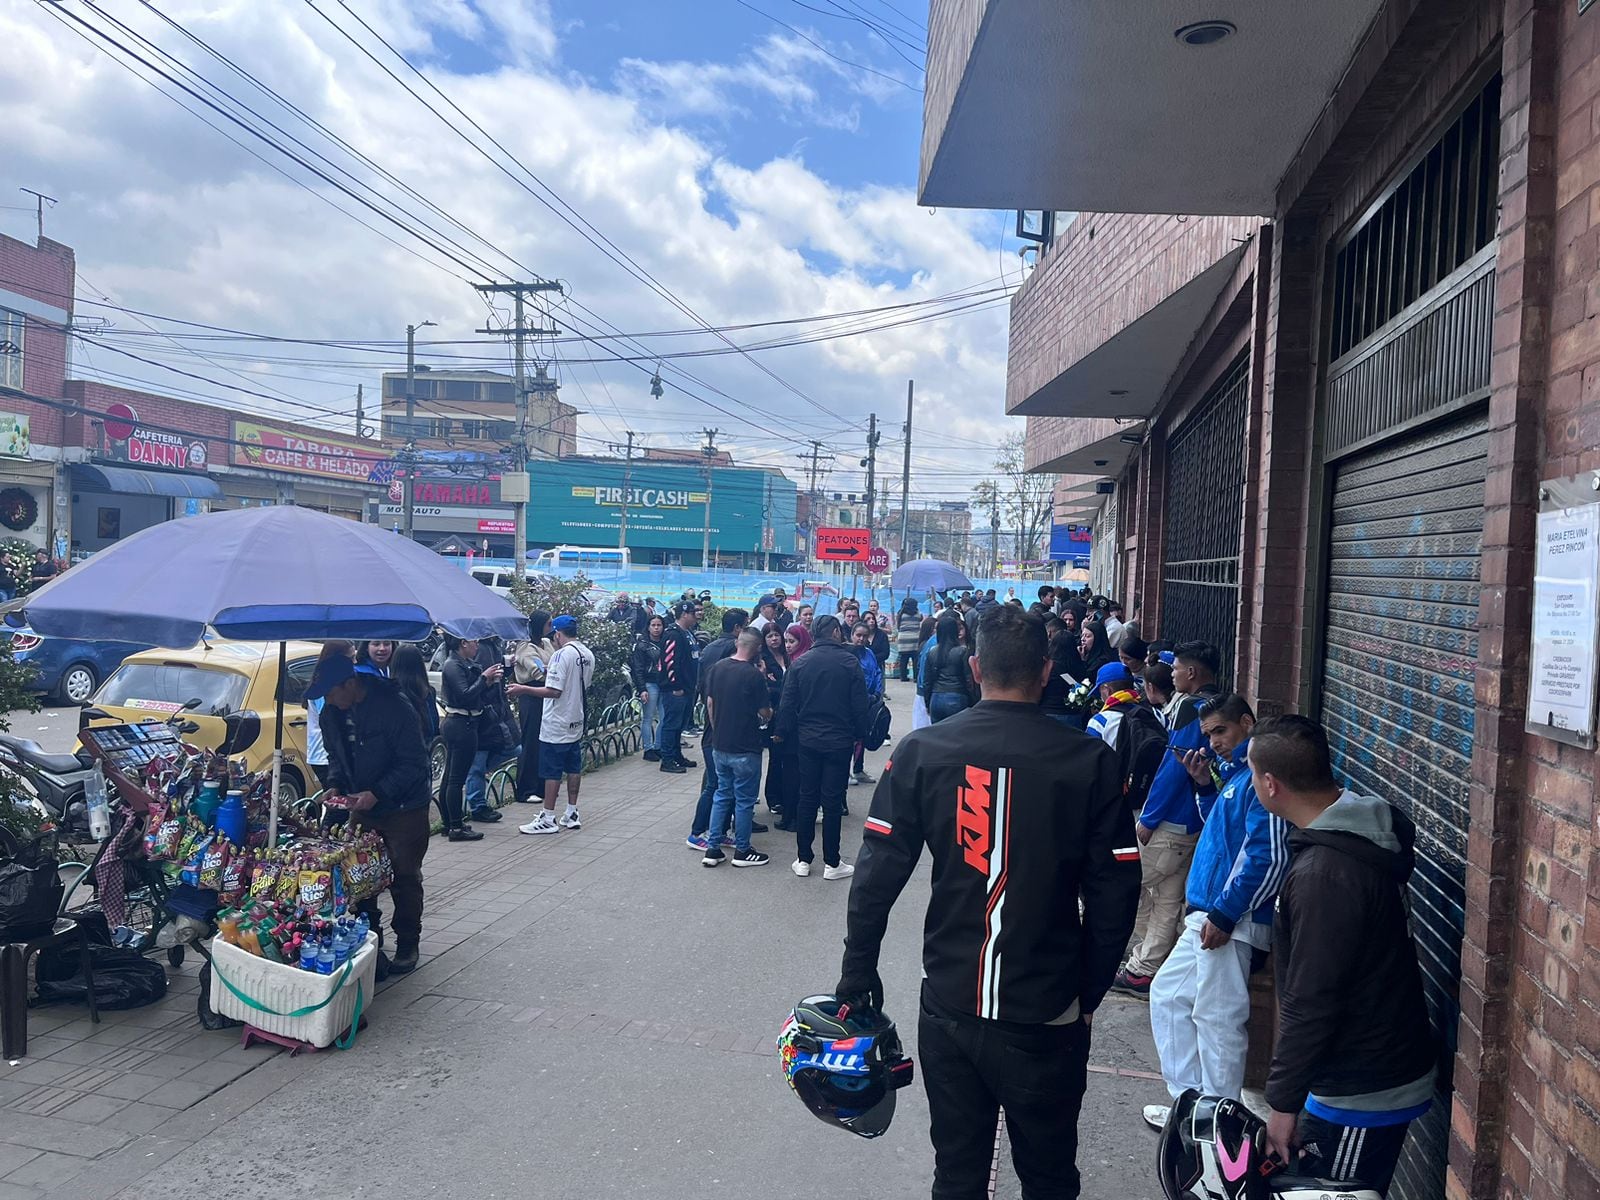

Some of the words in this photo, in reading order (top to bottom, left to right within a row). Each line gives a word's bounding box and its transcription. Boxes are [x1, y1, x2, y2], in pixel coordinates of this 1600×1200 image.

[134, 429, 182, 446] CAFETERIA
[128, 437, 188, 468] DANNY
[306, 455, 316, 469] &
[320, 459, 369, 477] HELADO
[414, 483, 492, 504] YAMAHA
[819, 535, 868, 544] PEATONES
[1548, 532, 1562, 542] MARIA
[1563, 528, 1588, 540] ETELVINA
[1549, 544, 1565, 555] PEREZ
[1566, 542, 1585, 552] RINCON
[866, 555, 886, 566] PARE
[956, 764, 992, 876] KTM
[300, 883, 325, 892] Todo
[301, 891, 324, 902] Rico
